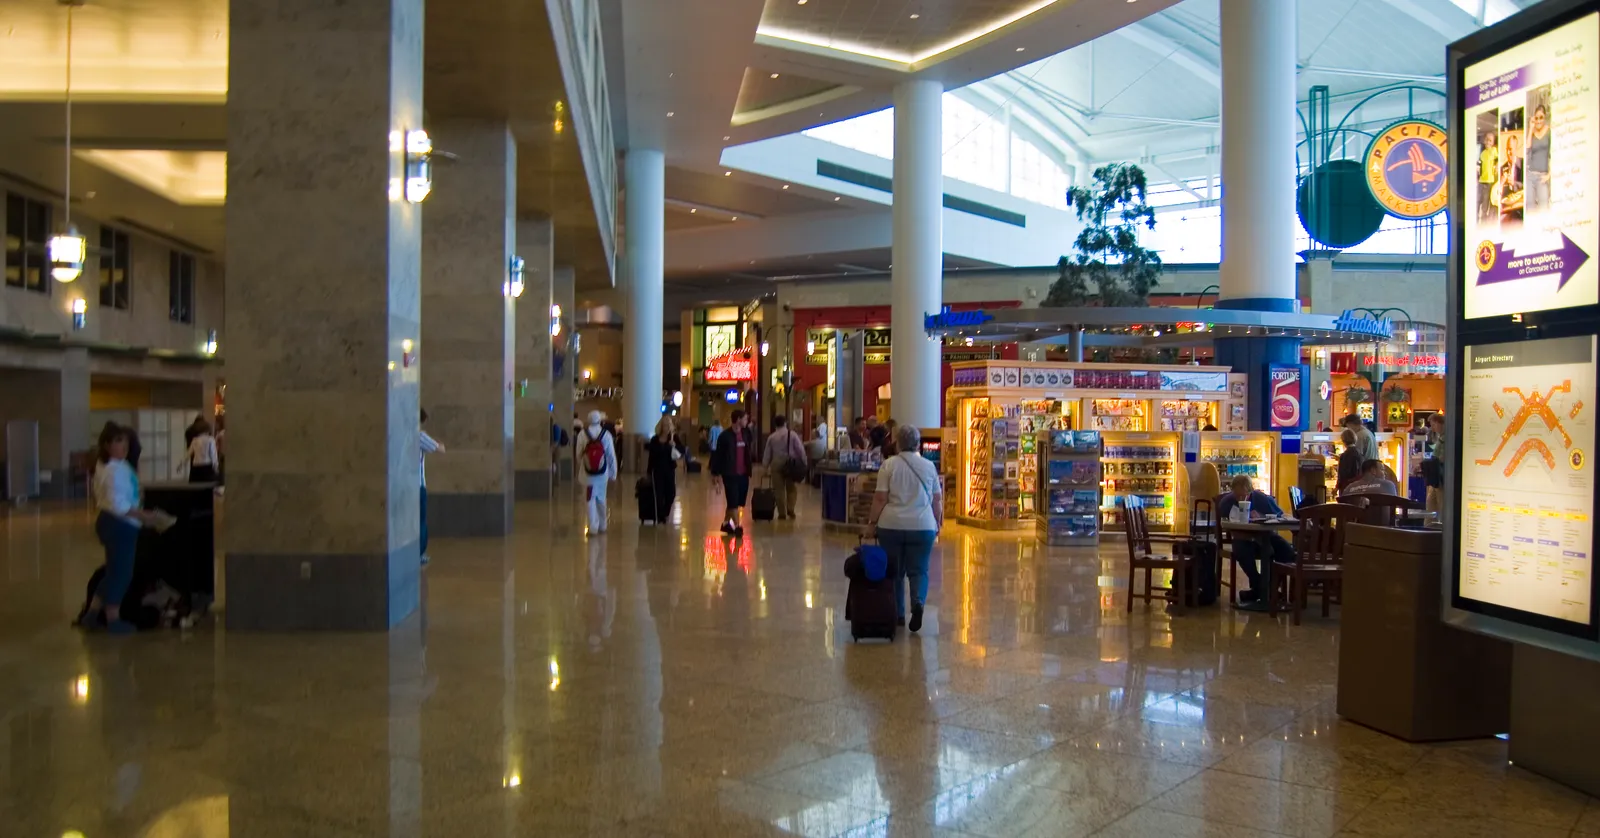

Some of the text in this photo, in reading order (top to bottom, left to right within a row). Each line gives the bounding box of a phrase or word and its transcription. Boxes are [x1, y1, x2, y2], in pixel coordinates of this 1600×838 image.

[1507, 260, 1523, 269] more
[1524, 258, 1531, 266] to
[1525, 265, 1549, 274] Concourse
[1558, 261, 1564, 269] D
[937, 305, 992, 327] News
[1332, 309, 1383, 334] Hudson
[810, 332, 849, 345] PIZA
[1363, 355, 1394, 365] MKI
[1397, 354, 1410, 365] of
[1474, 354, 1514, 364] Airport Directory
[1271, 371, 1300, 381] FORTUNE
